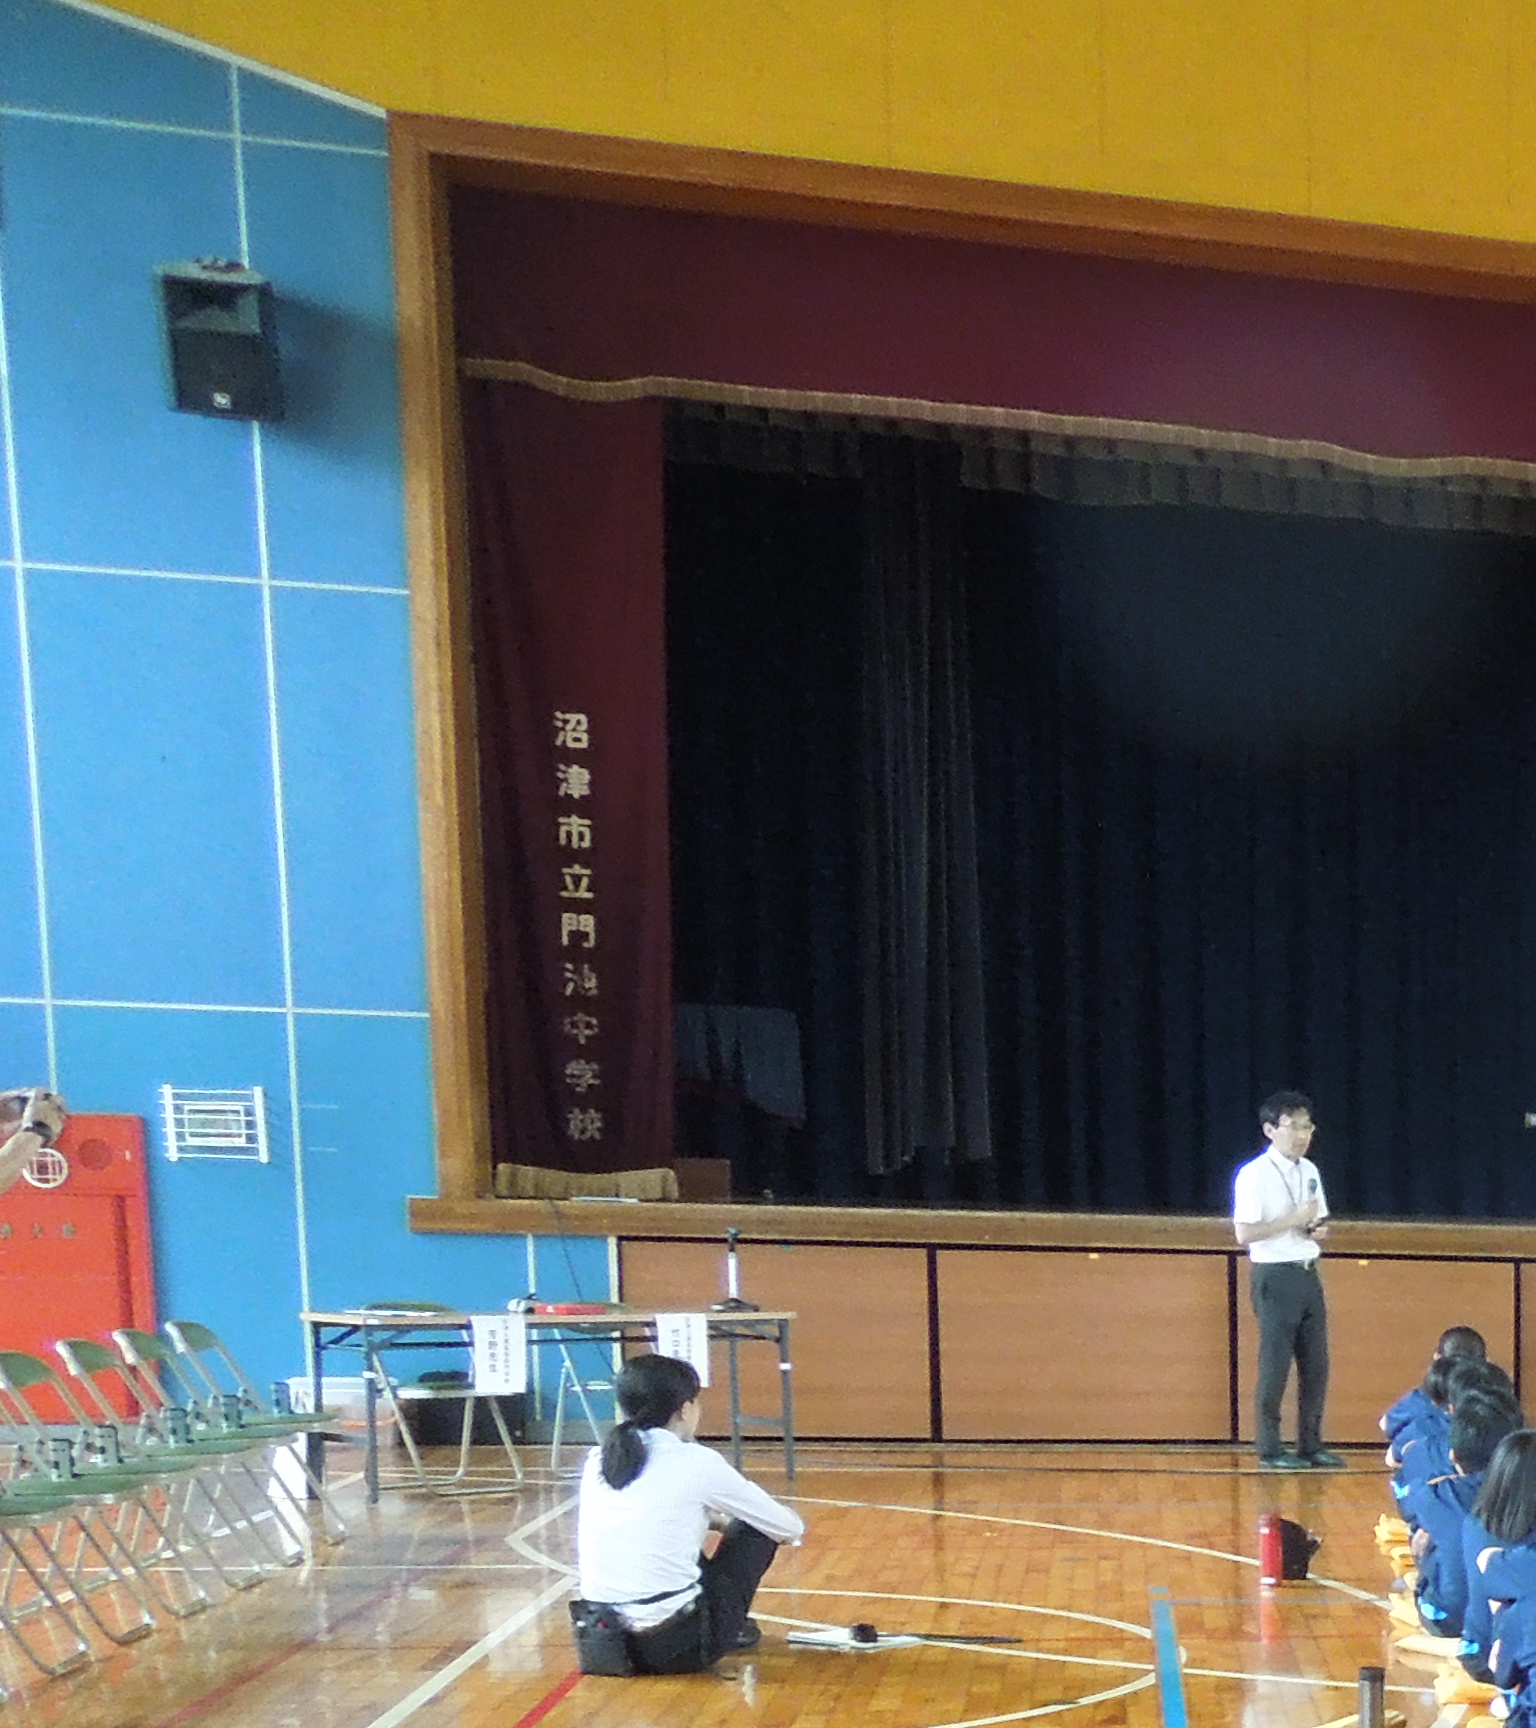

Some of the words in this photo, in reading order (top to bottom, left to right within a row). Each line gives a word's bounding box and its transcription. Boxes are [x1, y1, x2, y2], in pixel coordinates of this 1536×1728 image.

[553, 711, 603, 1140] 沼津市立門池中学校
